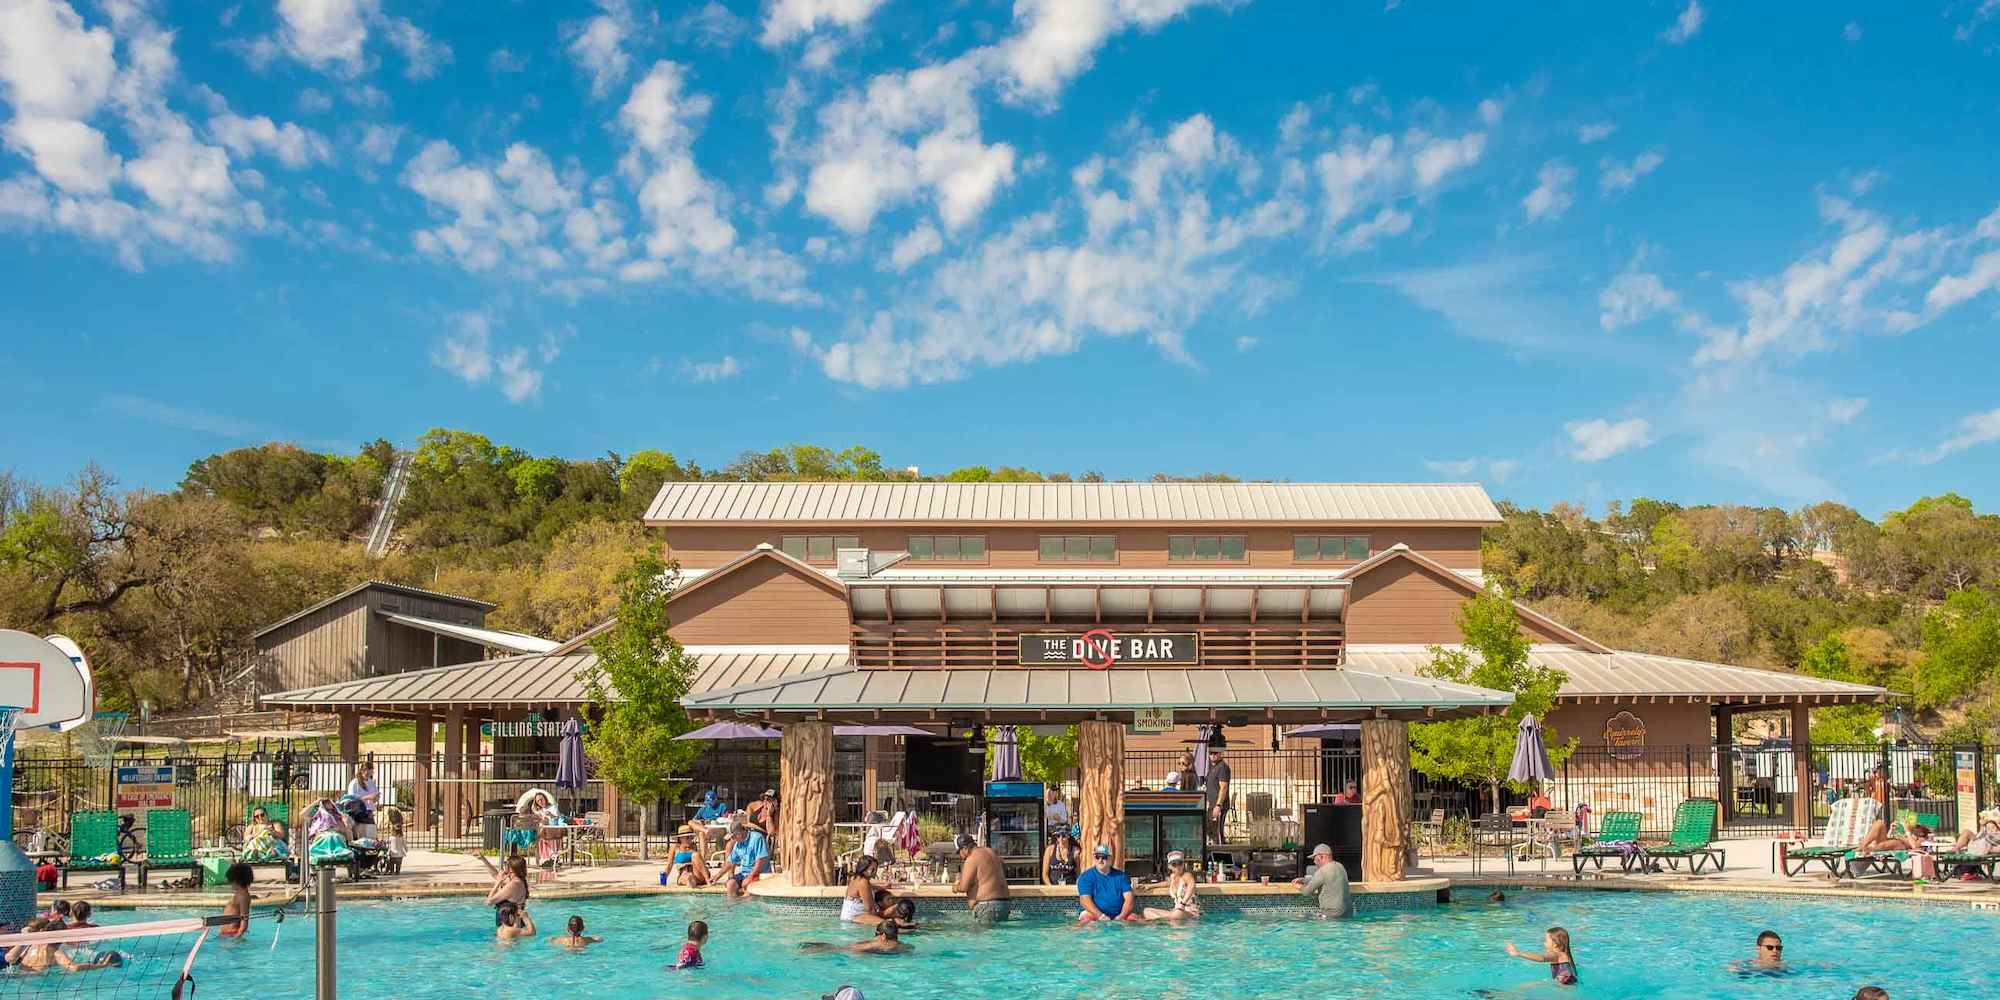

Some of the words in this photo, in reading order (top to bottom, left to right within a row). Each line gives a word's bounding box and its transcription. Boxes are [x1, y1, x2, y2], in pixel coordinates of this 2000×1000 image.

[1044, 640, 1066, 649] THE
[1072, 639, 1121, 658] DIVE
[1131, 639, 1173, 658] BAR
[491, 721, 532, 736] FILLING
[536, 721, 566, 736] STATI
[1137, 719, 1171, 727] SMOKING
